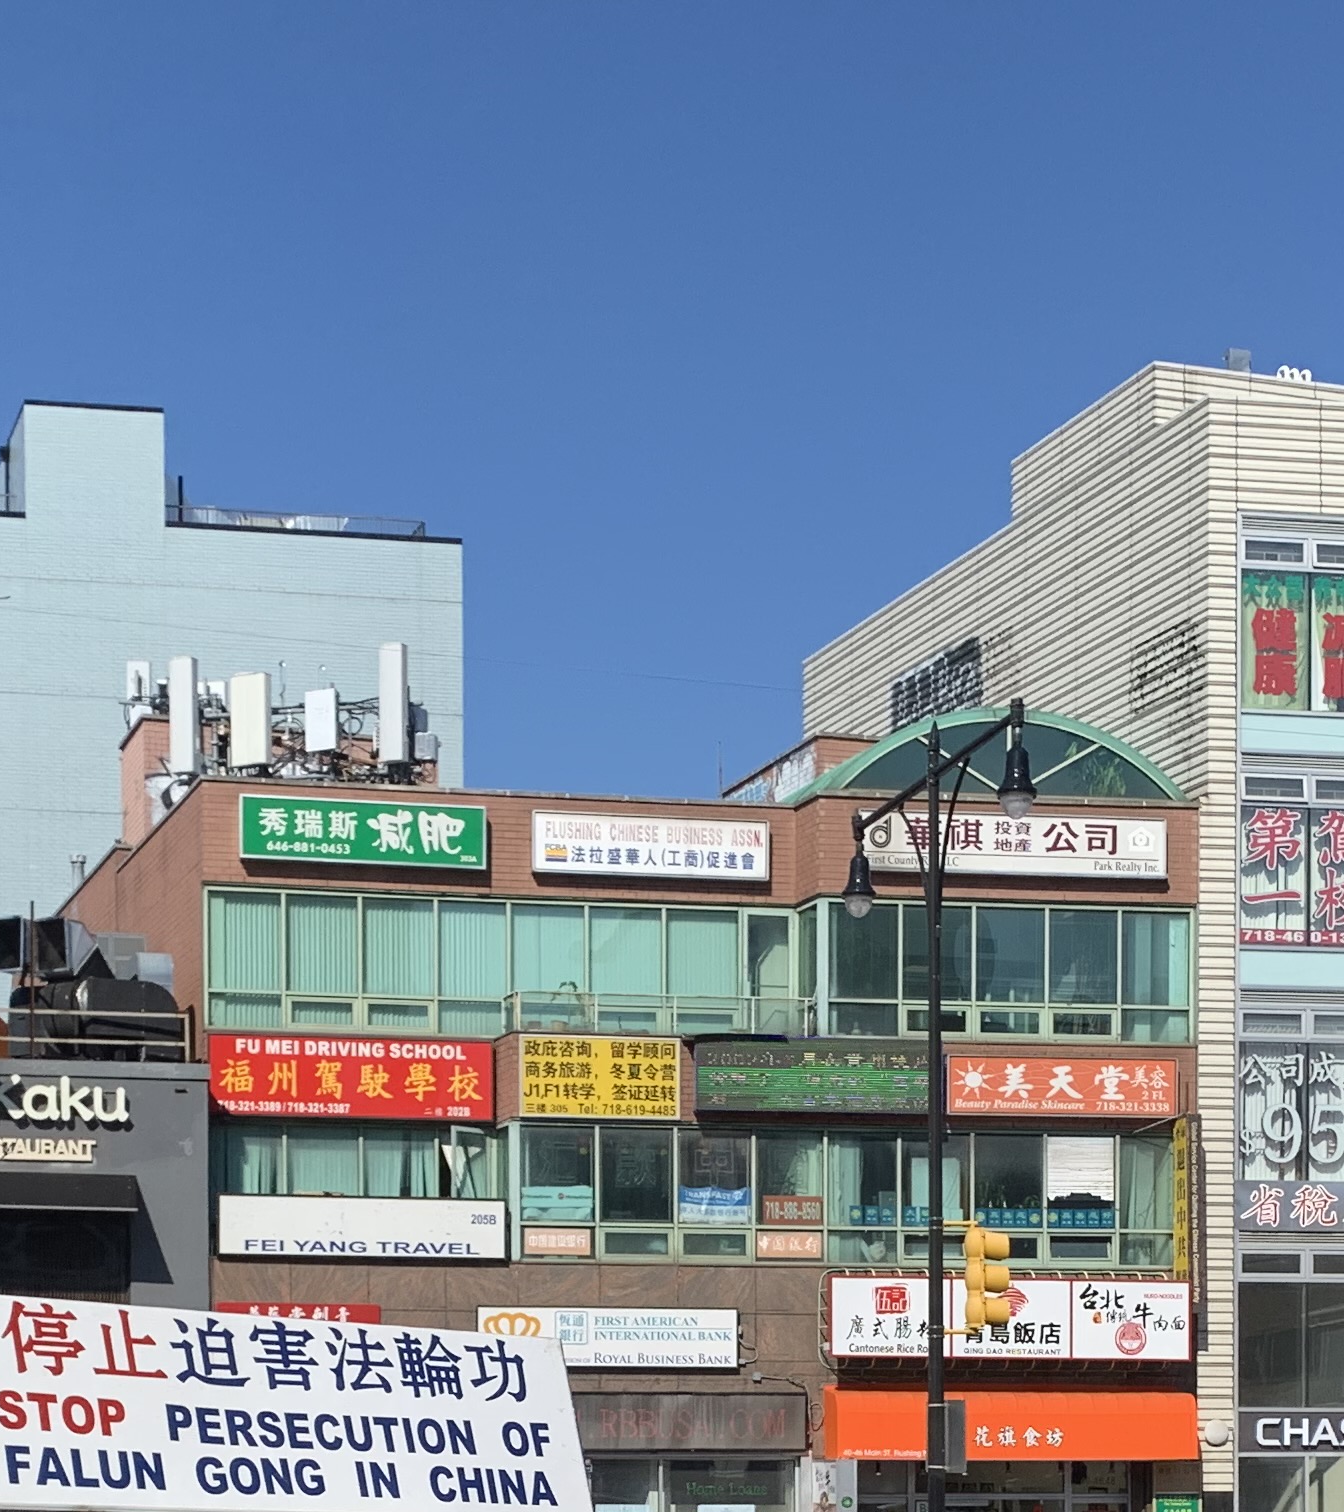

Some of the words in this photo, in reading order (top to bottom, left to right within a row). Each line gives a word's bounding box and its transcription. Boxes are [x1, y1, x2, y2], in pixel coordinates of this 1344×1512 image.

[545, 820, 602, 841] FLUSHING
[609, 823, 659, 843] CHINESE
[667, 826, 723, 846] BUSINESS
[731, 829, 764, 848] ASSN.
[1043, 820, 1118, 855] 公司
[266, 840, 351, 855] 646-881-0453
[1093, 861, 1113, 871] Park
[1115, 861, 1142, 875] Realty
[236, 1038, 260, 1054] FU
[266, 1039, 299, 1056] MEI
[304, 1041, 384, 1058] DRIVING
[389, 1043, 466, 1060] SCHOOL
[1142, 1090, 1149, 1100] 2
[1152, 1090, 1166, 1100] FL
[578, 1103, 598, 1114] Tel:
[602, 1104, 676, 1116] 718-619-4485
[955, 1098, 991, 1111] Beauty
[993, 1099, 1038, 1110] Paradise
[1040, 1099, 1085, 1110] Skincare
[1096, 1101, 1170, 1112] 718-321-3338
[471, 1214, 496, 1225] 205B
[245, 1239, 284, 1251] FEI
[293, 1240, 367, 1253] YANG
[377, 1241, 480, 1255] TRAVEL
[594, 1316, 629, 1326] FIRST
[631, 1316, 699, 1326] AMERICAN
[594, 1330, 697, 1341] INTERNATIONAL
[699, 1331, 732, 1342] BANK
[1, 1300, 529, 1403] 停止迫害法輪功
[849, 1344, 895, 1353] Cantonese
[897, 1344, 915, 1353] Rice
[1006, 1348, 1061, 1356] RESTAURANT
[594, 1353, 633, 1365] ROYAL
[637, 1353, 695, 1365] BUSINESS
[698, 1353, 732, 1365] BANK
[168, 1406, 474, 1456] PERSECUTION
[503, 1420, 550, 1457] OF
[5, 1445, 166, 1490] FALUN
[195, 1456, 324, 1496] GONG
[356, 1461, 400, 1498] IN
[430, 1465, 558, 1506] CHINA
[686, 1482, 724, 1496] Home
[729, 1482, 768, 1496] Loans
